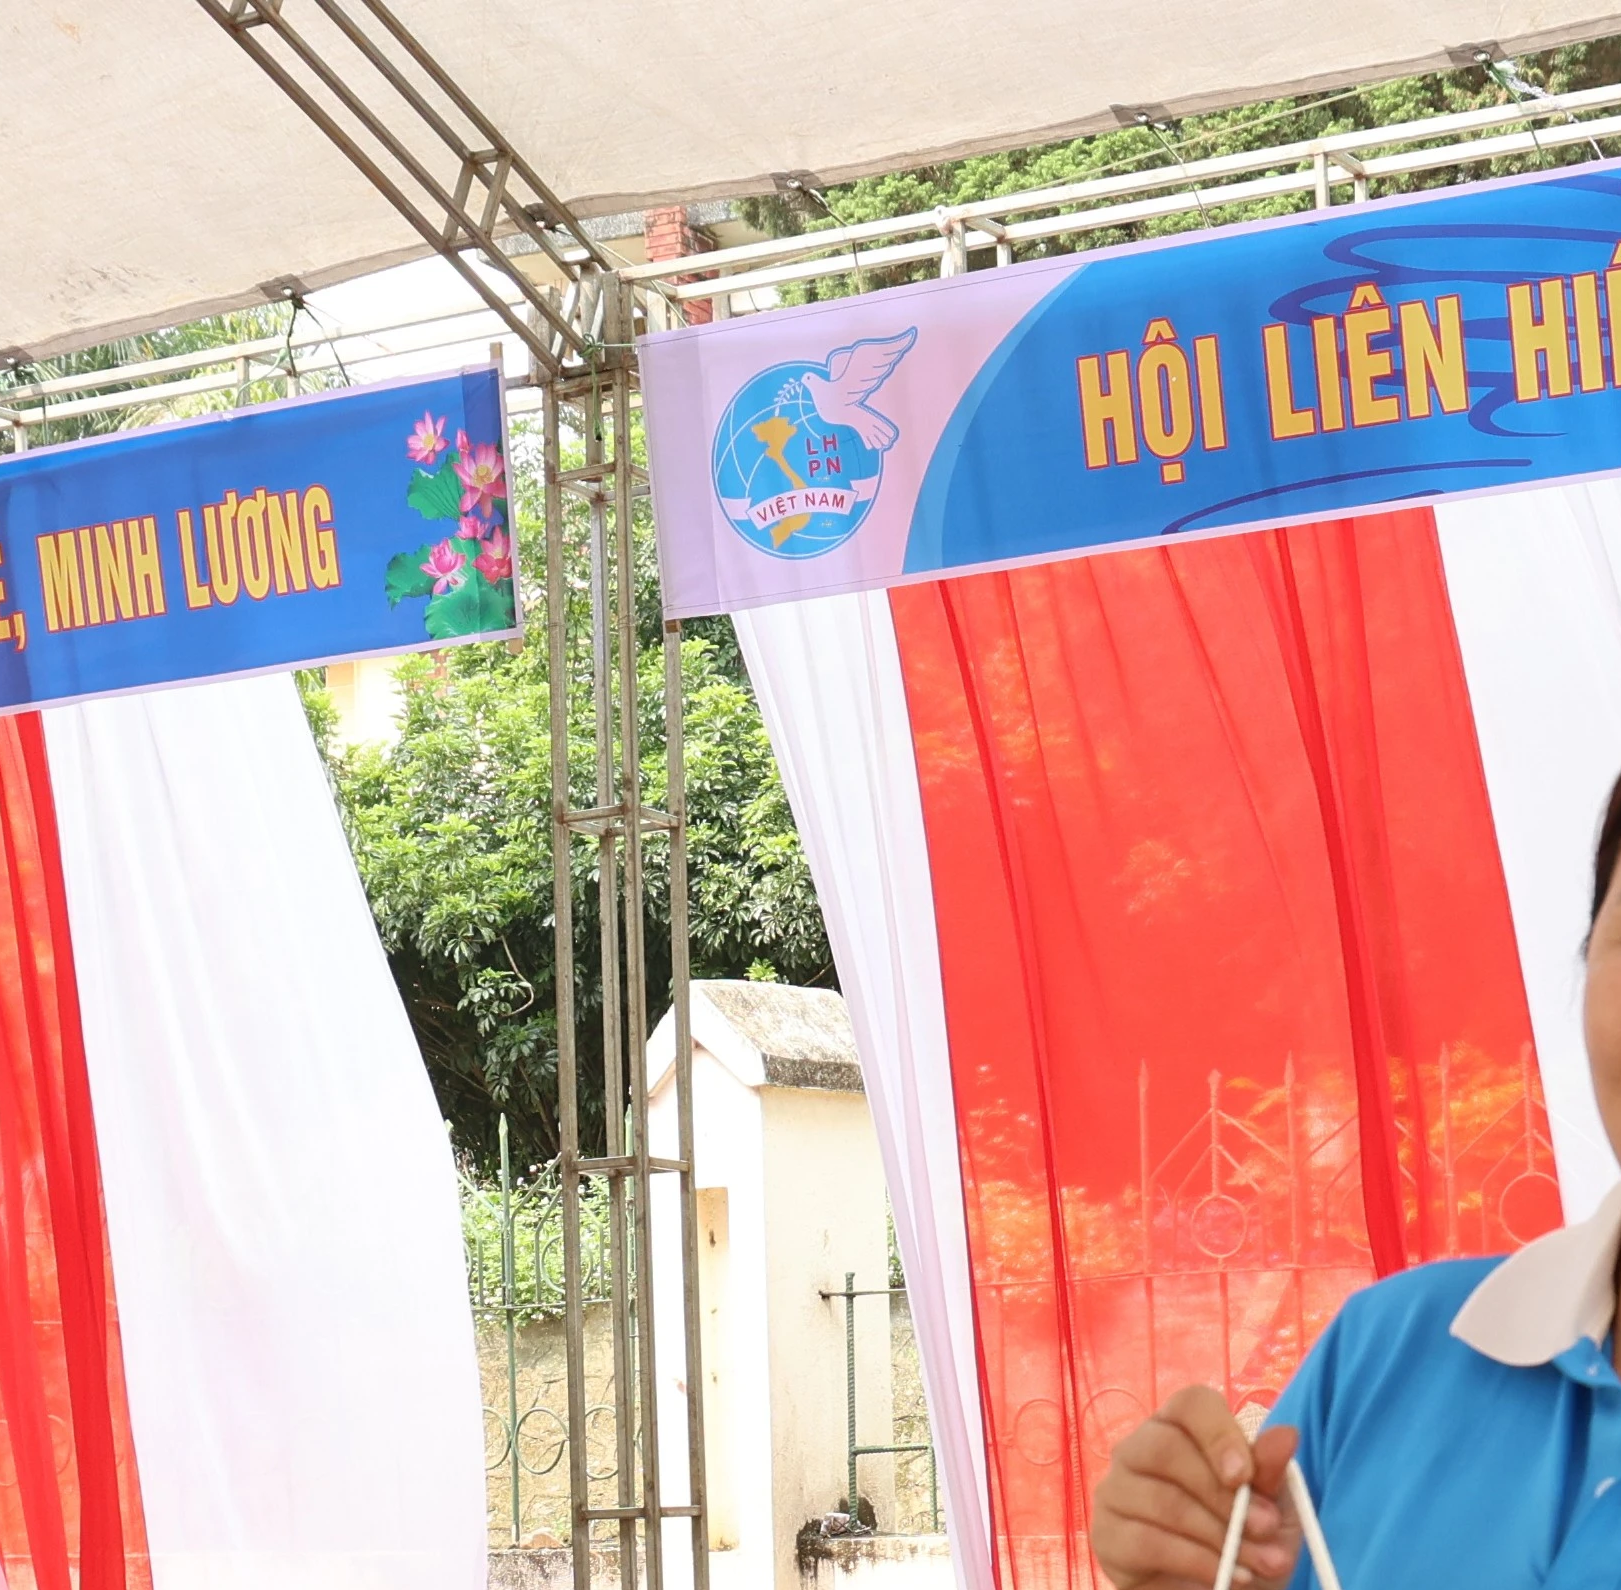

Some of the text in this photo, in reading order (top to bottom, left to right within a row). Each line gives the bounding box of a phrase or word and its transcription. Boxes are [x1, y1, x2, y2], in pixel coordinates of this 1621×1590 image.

[1076, 317, 1226, 485] HỘI
[1261, 282, 1470, 443] LIÊN
[36, 515, 167, 633] MINH
[176, 483, 342, 610] LƯƠNG
[756, 492, 845, 522] VIỆT NAM
